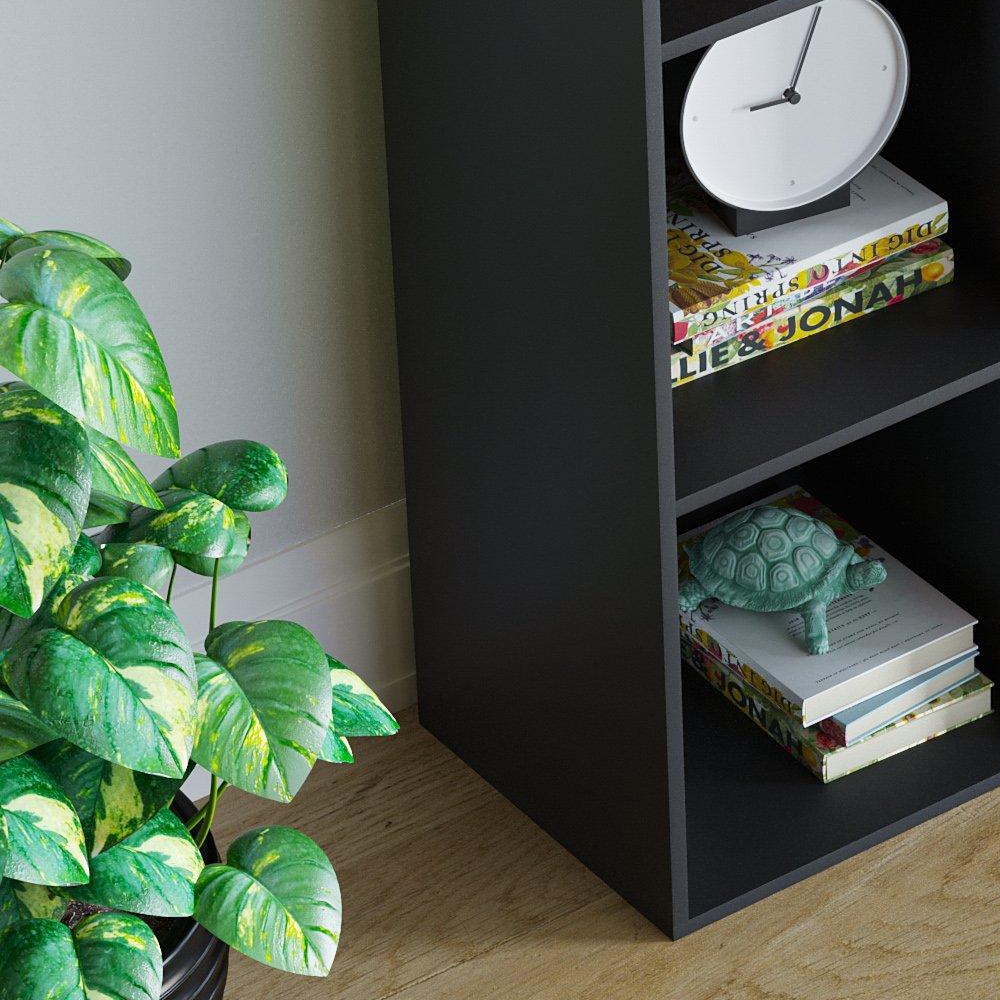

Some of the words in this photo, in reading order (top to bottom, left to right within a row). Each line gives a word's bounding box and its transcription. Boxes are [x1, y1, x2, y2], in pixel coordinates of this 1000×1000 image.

[888, 220, 932, 247] DIG
[702, 277, 799, 327] SPRING
[737, 331, 766, 357] &
[782, 271, 923, 340] JONAH
